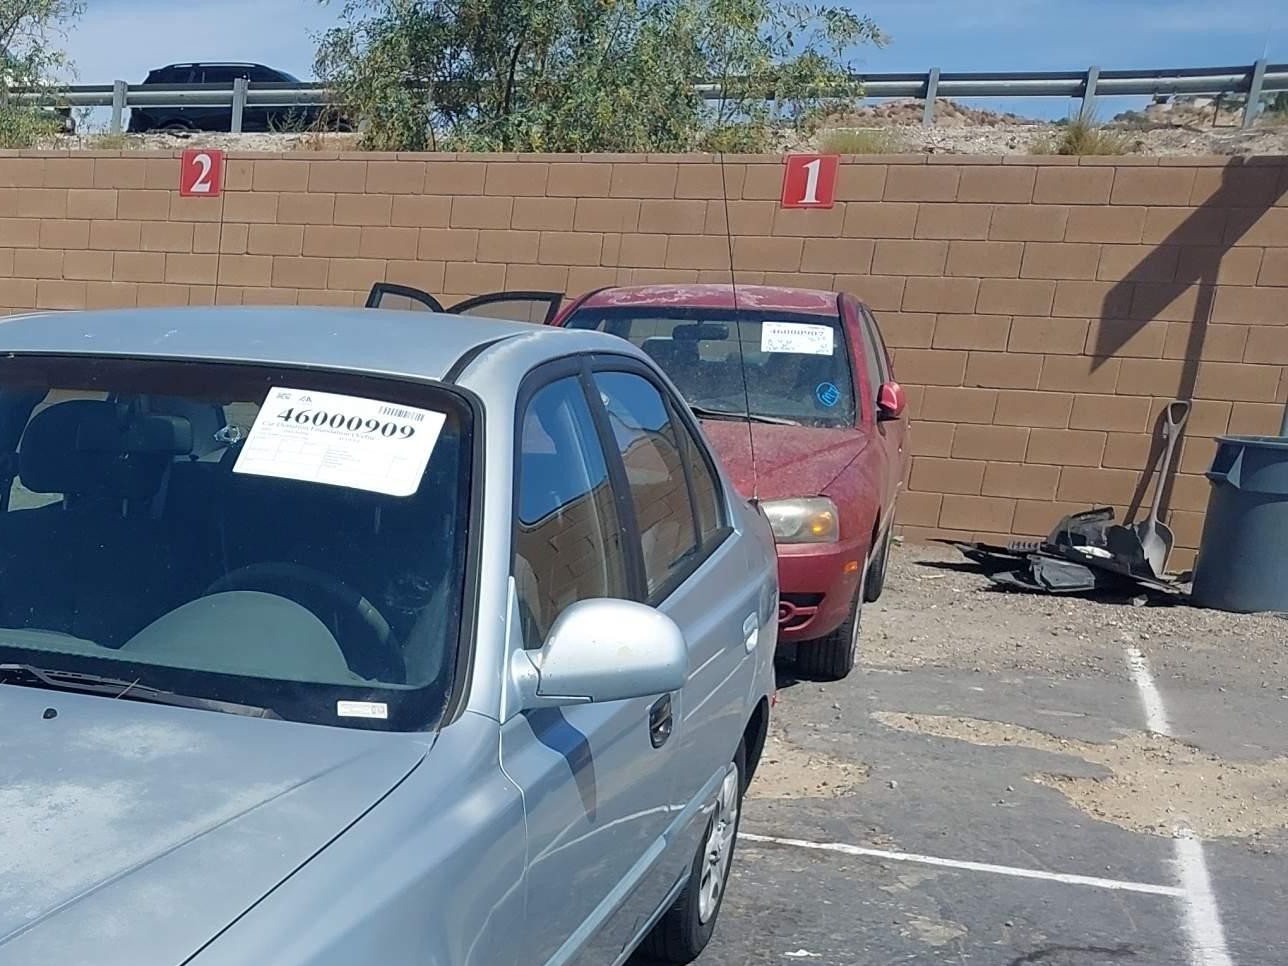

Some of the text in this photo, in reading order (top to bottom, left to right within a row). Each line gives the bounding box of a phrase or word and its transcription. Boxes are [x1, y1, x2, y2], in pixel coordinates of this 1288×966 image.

[190, 153, 212, 193] 2
[797, 158, 822, 204] 1
[276, 407, 416, 440] 46000909
